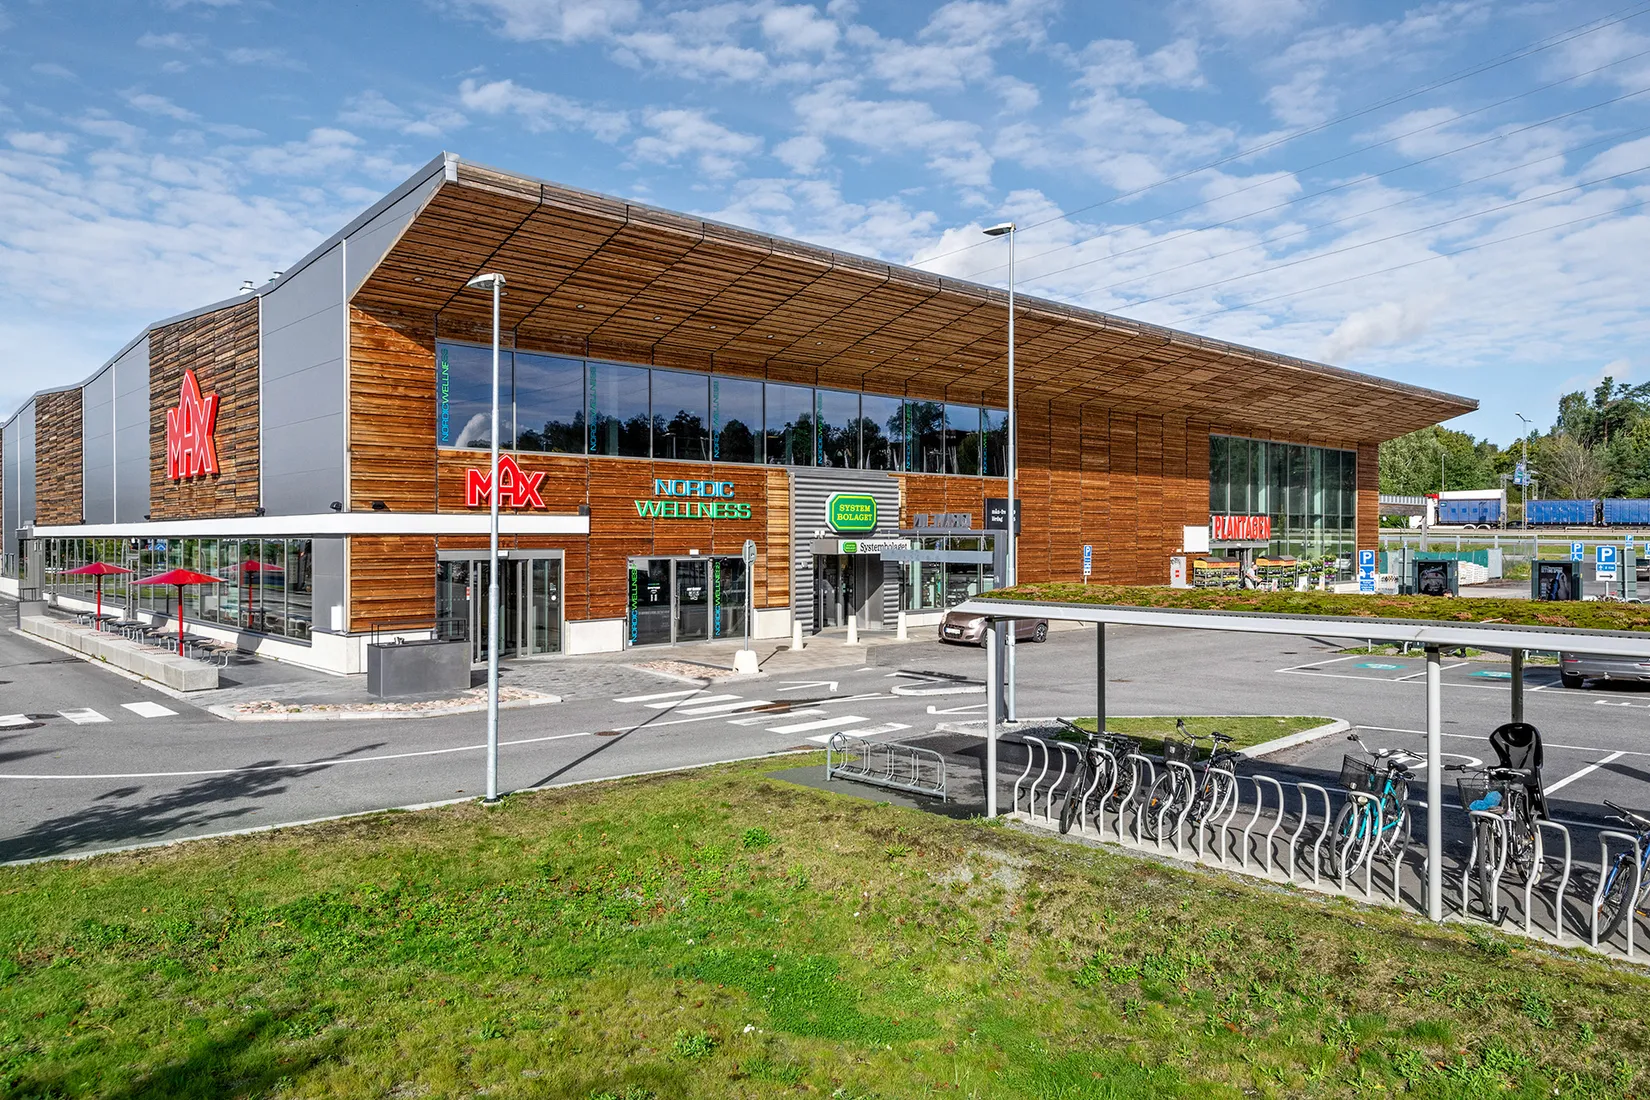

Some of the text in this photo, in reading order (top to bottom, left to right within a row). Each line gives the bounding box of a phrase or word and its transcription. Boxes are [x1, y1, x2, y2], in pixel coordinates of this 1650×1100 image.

[167, 369, 219, 480] MAX
[465, 453, 547, 508] MAX
[655, 478, 735, 498] NORDIC
[634, 500, 752, 519] WELLNESS
[839, 504, 871, 512] SYSTEM
[837, 513, 873, 521] BOLAGET
[1212, 515, 1271, 540] PLANTAGEN
[1574, 543, 1581, 552] P
[1601, 548, 1613, 561] P
[1362, 551, 1372, 564] P
